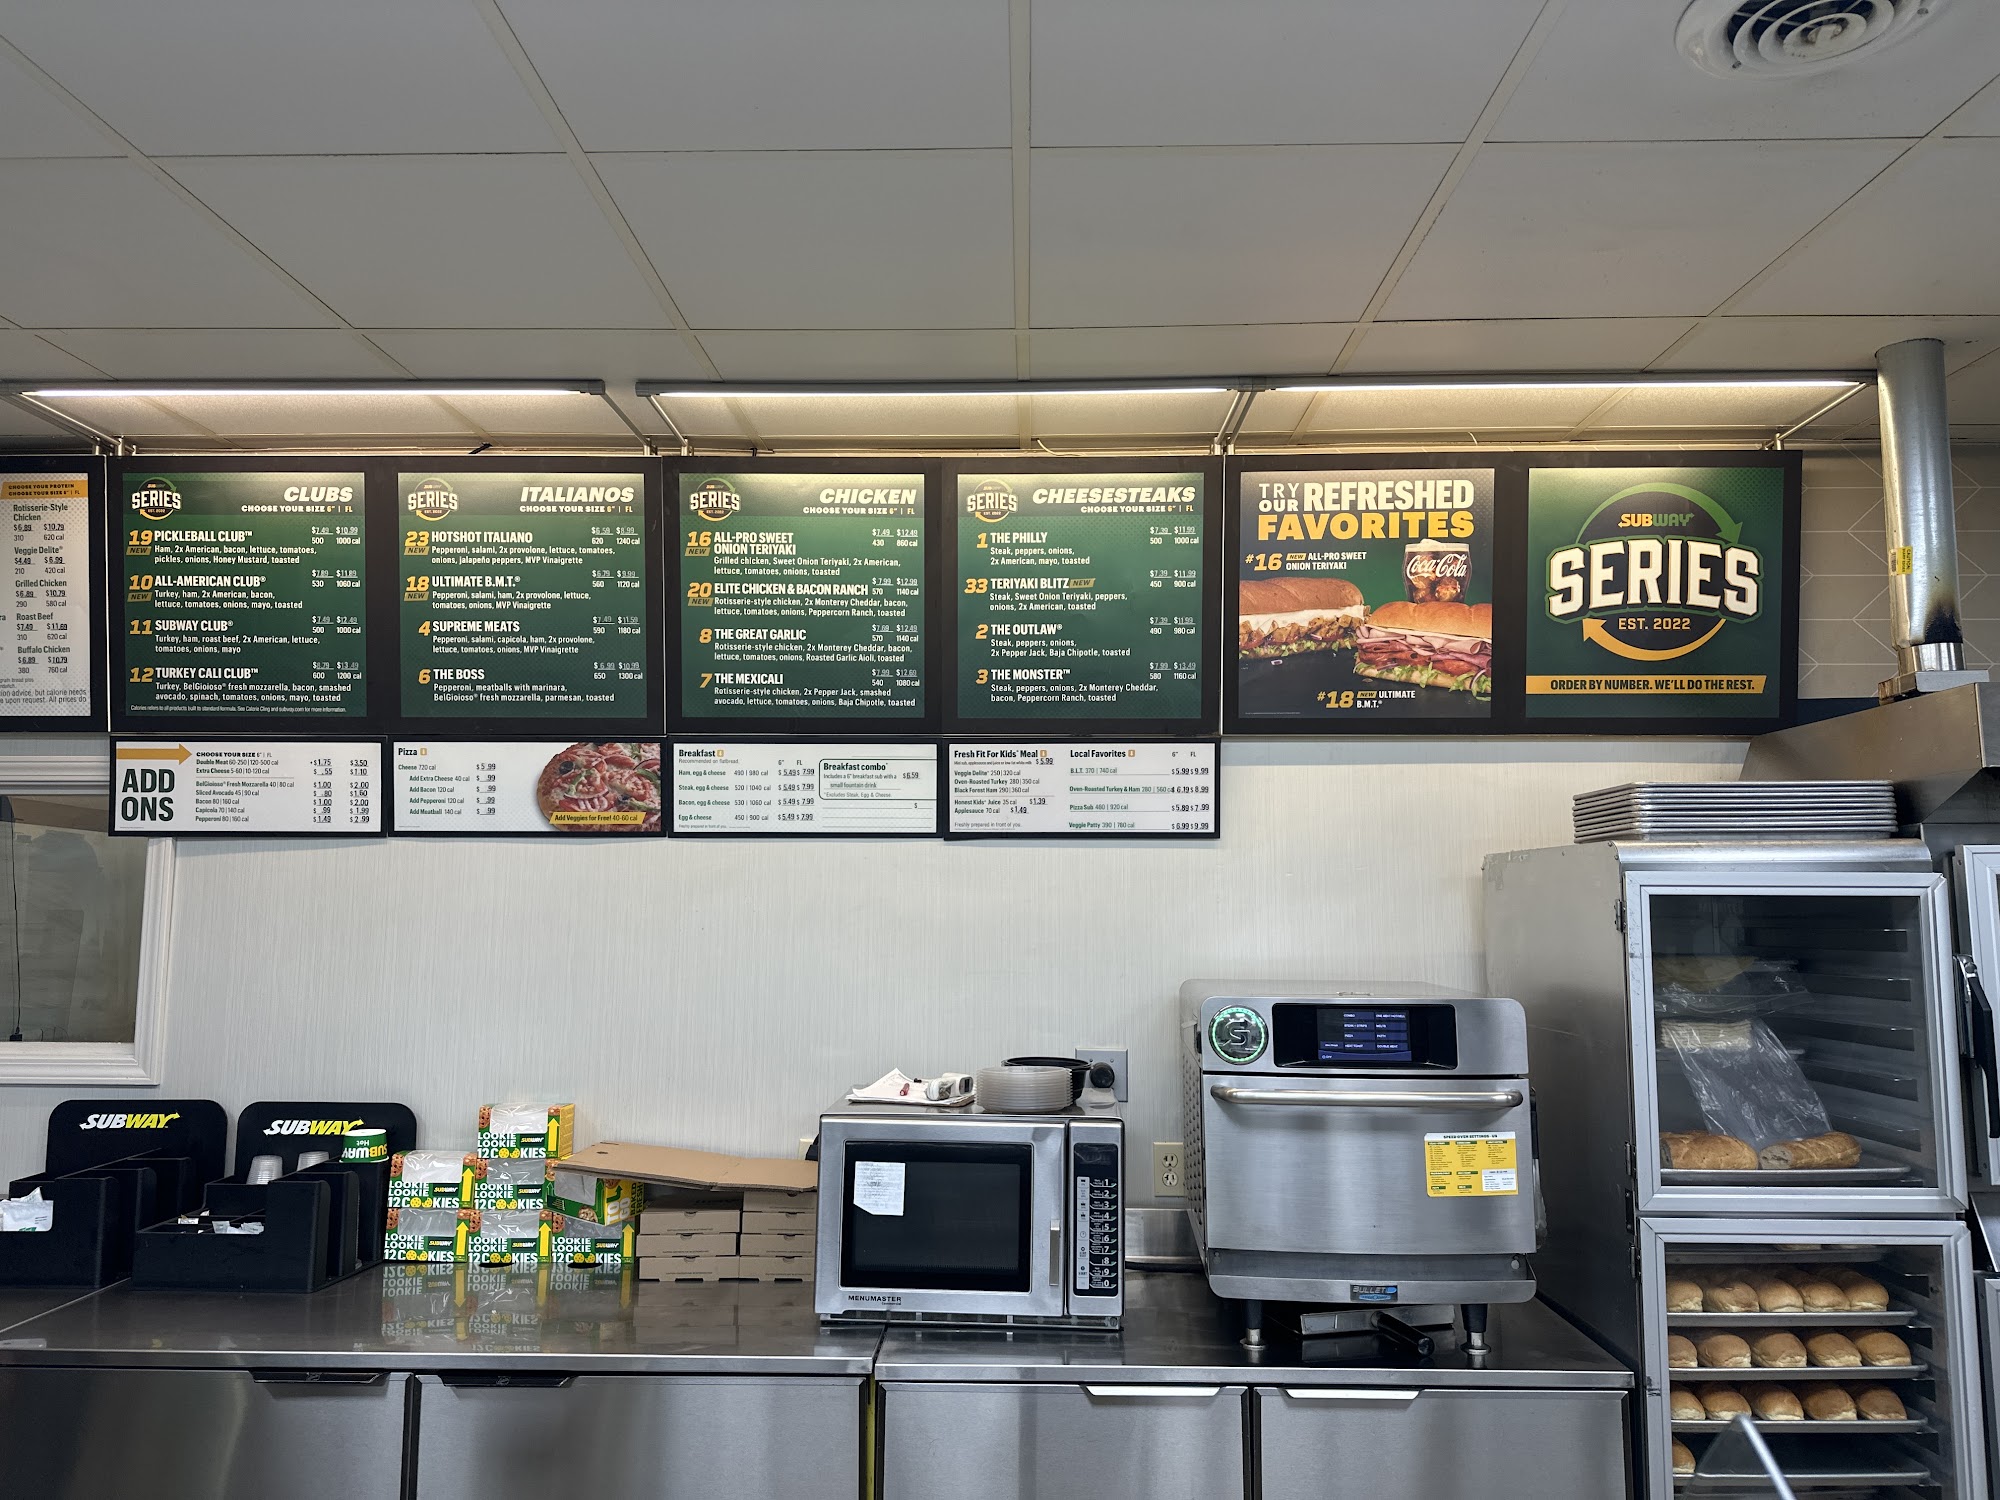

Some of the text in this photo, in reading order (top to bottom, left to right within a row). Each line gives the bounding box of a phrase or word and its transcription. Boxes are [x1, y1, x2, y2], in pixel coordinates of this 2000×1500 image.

[283, 486, 354, 502] CLUBS
[520, 487, 634, 502] ITALIANOS
[819, 488, 916, 505] CHICKEN
[1032, 487, 1196, 504] CHEESESTEAKS
[1258, 483, 1300, 498] TRY
[1303, 480, 1475, 511] REFRESHED
[130, 491, 182, 510] SERIES
[407, 491, 458, 510] SERIES
[689, 492, 741, 511] SERIES
[966, 492, 1018, 512] SERIES
[1258, 498, 1299, 512] OUR
[1258, 512, 1475, 540] FAVORITES
[1618, 512, 1694, 528] SUBWAY
[128, 530, 152, 545] 19
[154, 530, 216, 542] PICKLEBALL
[404, 531, 429, 546] 23
[432, 531, 532, 543] HOTSHOT ITALIANO
[686, 531, 711, 546] 16
[714, 532, 794, 544] ALL-PRO SWEET
[976, 533, 988, 548] 1
[990, 532, 1048, 544] THE PHILLY
[714, 543, 796, 555] ONION TERIYAKI
[991, 546, 1074, 555] Steak, peppers, onions,
[1308, 552, 1367, 560] ALL-PRO SWEET
[1245, 553, 1283, 571] #16
[1286, 562, 1346, 570] ONION TERIYAKI
[1406, 553, 1468, 579] Coca-Cola
[714, 567, 840, 576] lettuce, tomatoes, onions, toasted
[1548, 539, 1760, 617] SERIES
[15, 579, 67, 588] Grilled Chicken
[129, 575, 153, 590] 10
[155, 575, 231, 588] ALL-AMERICAN
[405, 576, 429, 591] 18
[433, 576, 482, 588] ULTIMATE
[964, 578, 988, 593] 33
[991, 578, 1069, 590] TERIYAKI BLITZ
[687, 582, 712, 597] 20
[715, 583, 868, 595] ELITE CHICKEN & BACON RANCH
[433, 601, 551, 610] tomatoes, onions, MVP Vinaigrette
[16, 612, 53, 621] Roast Beef
[129, 620, 152, 634] 11
[155, 619, 199, 632] SUBWAY
[418, 621, 430, 636] 4
[432, 620, 520, 632] SUPREME MEATS
[991, 623, 1011, 635] THE
[1618, 618, 1691, 630] EST. 2022
[699, 628, 712, 643] 8
[714, 628, 806, 640] THE GREAT GARLIC
[975, 624, 988, 639] 2
[18, 645, 70, 654] Buffalo Chicken
[155, 645, 192, 653] tomatoes,
[194, 645, 220, 653] onions,
[129, 668, 154, 682] 12
[156, 667, 196, 679] TURKEY
[199, 667, 221, 679] CALI
[418, 669, 431, 684] 6
[434, 668, 484, 680] THE BOSS
[715, 673, 783, 685] THE MEXICALI
[976, 669, 988, 684] 3
[992, 668, 1010, 680] THE
[700, 673, 712, 688] 7
[1551, 679, 1754, 690] ORDER BY NUMBER. WE'LL DO THE REST.
[1317, 691, 1354, 708] #18
[1378, 690, 1416, 699] ULTIMATE
[398, 747, 418, 756] Pizza
[678, 749, 716, 758] Breakfast
[954, 749, 975, 758] Fresh
[976, 749, 986, 758] Fit
[987, 749, 999, 758] For
[1020, 749, 1038, 758] Meal
[1070, 749, 1126, 758] Local Favorites
[824, 762, 860, 772] Breakfast
[122, 768, 175, 793] ADD
[121, 797, 174, 822] ONS
[79, 1112, 181, 1130] SUBWAY
[262, 1119, 364, 1136] SUBWAY
[477, 1132, 517, 1140] LOOKIE
[342, 1144, 388, 1158] SUBWAY
[607, 1201, 619, 1224] TO
[620, 1197, 631, 1219] GO
[384, 1234, 424, 1242] LOOKIE
[552, 1237, 591, 1245] LOOKIE
